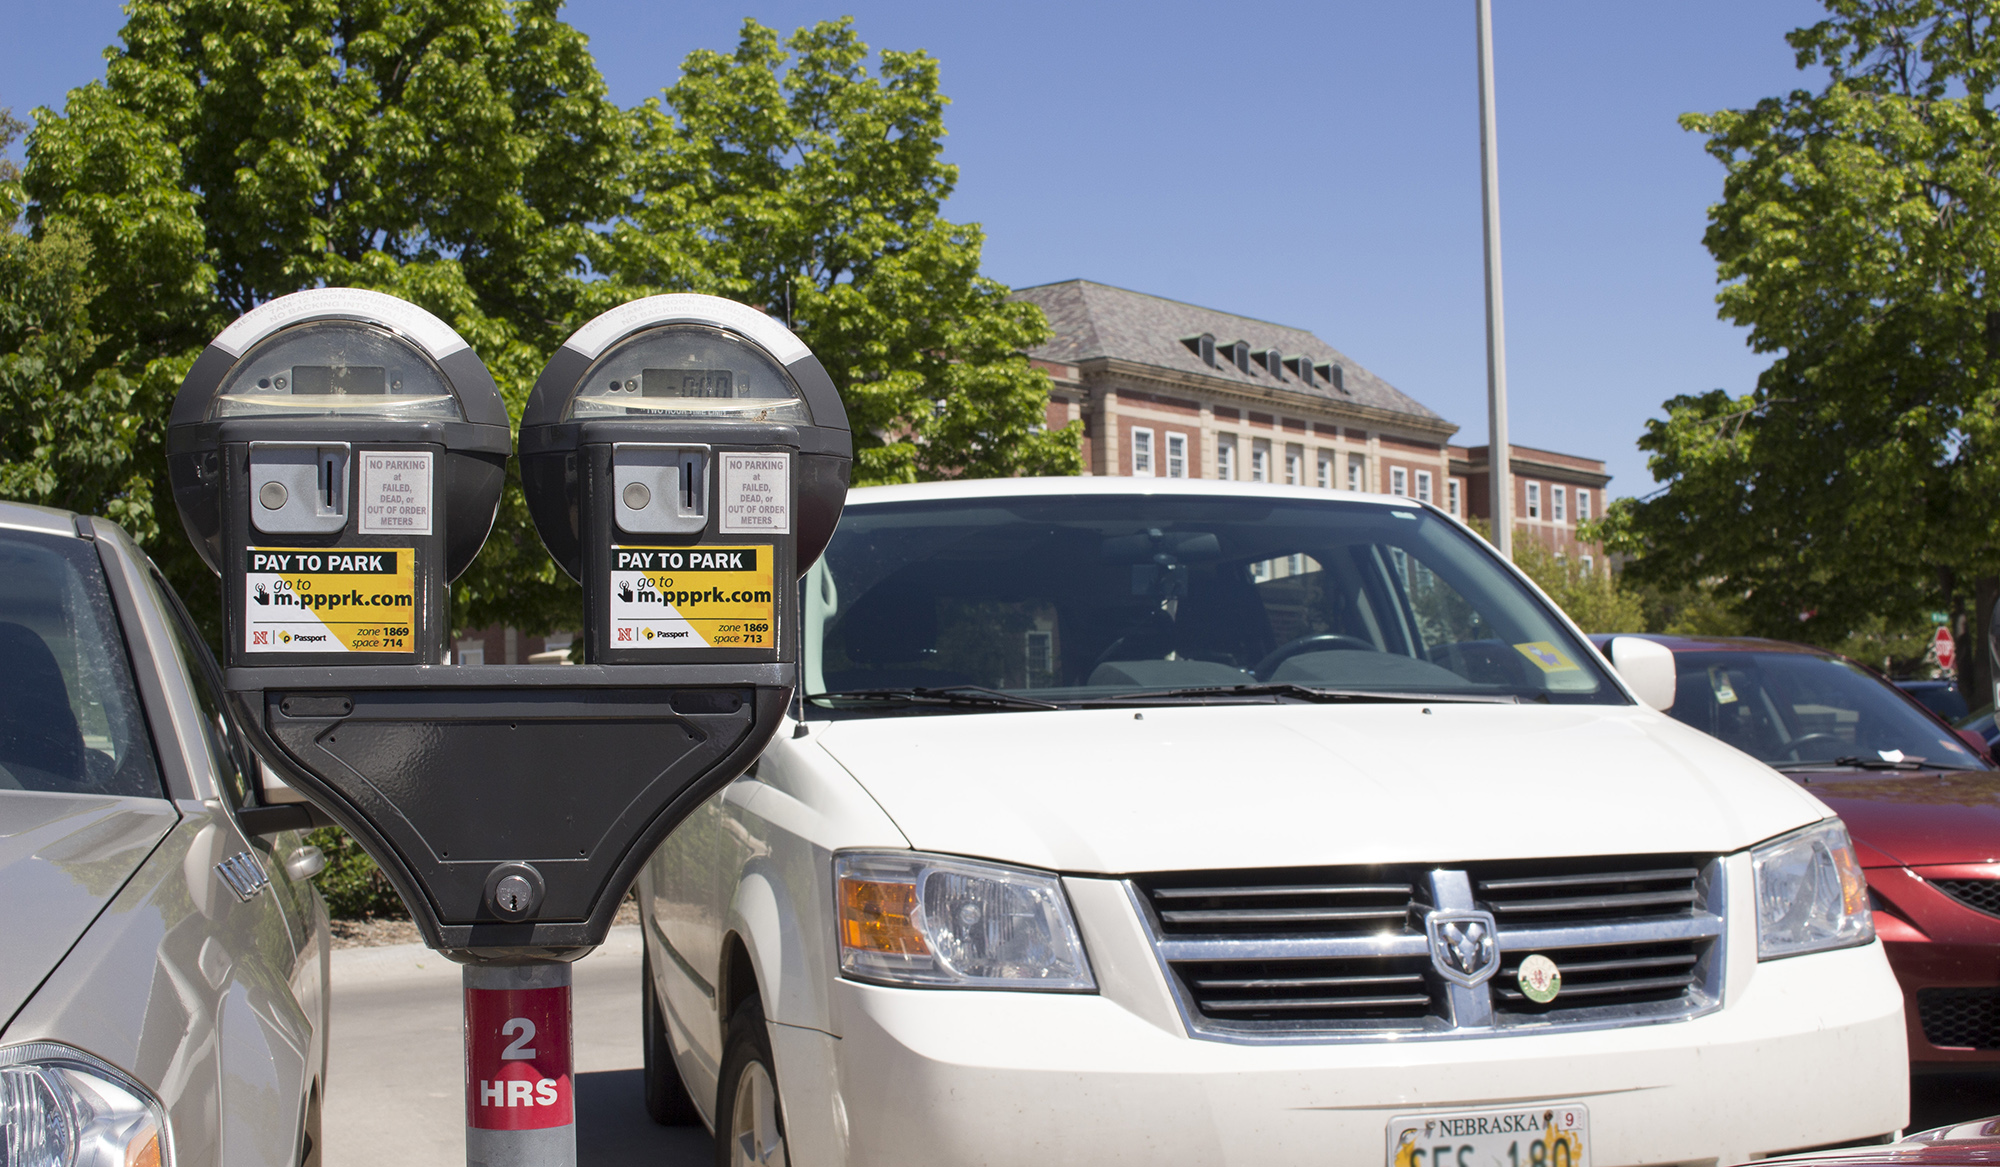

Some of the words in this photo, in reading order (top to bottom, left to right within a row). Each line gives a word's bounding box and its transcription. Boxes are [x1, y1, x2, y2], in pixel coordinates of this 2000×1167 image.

[349, 294, 414, 318] SATURDAYS
[699, 299, 762, 325] SATURDAYS
[233, 303, 274, 330] METERS
[269, 312, 286, 323] NO
[289, 301, 341, 314] BACKING
[343, 301, 370, 310] INTO
[373, 306, 411, 326] STALLS
[584, 306, 625, 333] METERS
[621, 315, 637, 326] NO
[640, 306, 690, 317] BACKING
[693, 306, 719, 315] INTO
[370, 461, 383, 469] NO
[386, 461, 426, 470] PARKING
[730, 461, 742, 469] NO
[745, 461, 783, 470] PARKING
[393, 473, 402, 481] at
[753, 473, 761, 481] at
[382, 484, 412, 494] FAILED,
[742, 484, 771, 493] FAILED,
[380, 495, 404, 504] DEAD,
[740, 495, 763, 504] DEAD,
[367, 506, 384, 514] OUT
[386, 506, 397, 514] OF
[399, 506, 426, 515] ORDER
[759, 506, 785, 514] ORDER
[381, 517, 413, 526] METERS
[741, 516, 772, 524] METERS
[254, 554, 291, 571] PAY
[296, 555, 322, 571] TO
[328, 555, 383, 571] PARK
[618, 553, 654, 568] PAY
[658, 553, 684, 569] TO
[689, 553, 743, 569] PARK
[273, 580, 292, 593] go
[296, 579, 311, 590] to
[637, 577, 656, 590] go
[659, 576, 674, 588] to
[274, 590, 412, 610] m.ppprk.com
[638, 587, 771, 607] m.ppprk.com
[357, 628, 380, 636] zone
[383, 627, 409, 636] 1869
[718, 624, 741, 632] zone
[743, 623, 769, 632] 1869
[253, 631, 268, 645] N
[294, 634, 327, 643] Passport
[618, 628, 632, 641] N
[657, 631, 689, 639] Passport
[713, 635, 740, 644] space
[743, 635, 762, 643] 713
[352, 639, 379, 648] space
[383, 639, 403, 647] 714
[1936, 640, 1952, 656] STOP
[501, 1017, 536, 1060] 2
[480, 1078, 558, 1107] HRS
[1439, 1114, 1540, 1138] NEBRASKA
[1565, 1113, 1574, 1127] 9
[1507, 1138, 1571, 1167] 180
